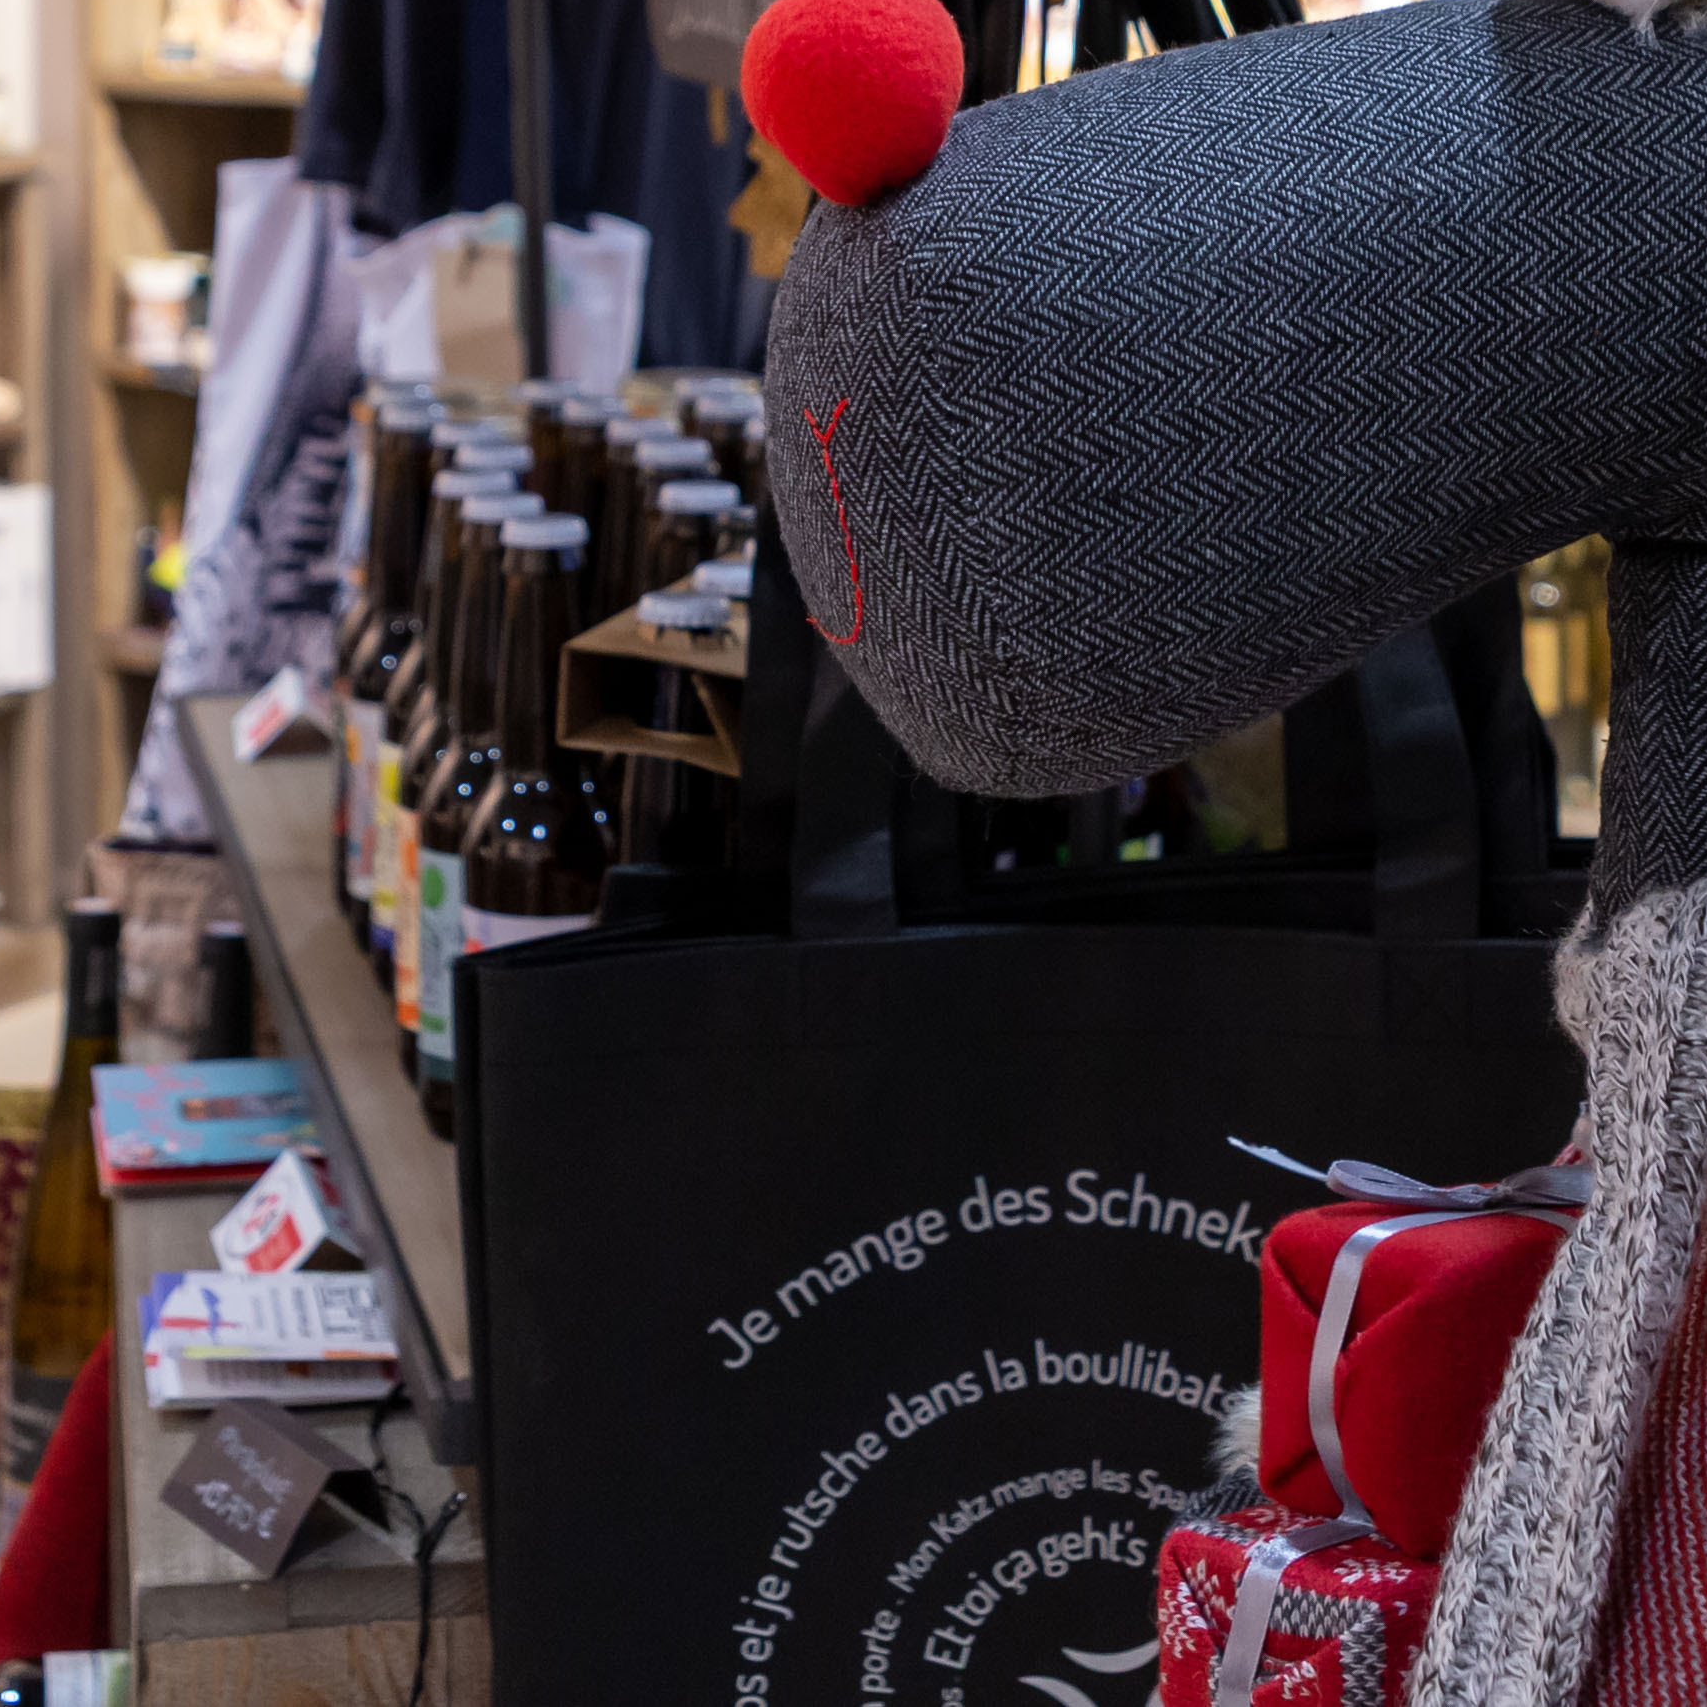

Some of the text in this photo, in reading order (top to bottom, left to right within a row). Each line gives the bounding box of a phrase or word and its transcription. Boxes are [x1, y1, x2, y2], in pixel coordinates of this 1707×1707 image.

[707, 1169, 1262, 1369] Je mange des Schnek
[984, 1349, 1027, 1393] la
[885, 1371, 983, 1438] dans
[770, 1432, 888, 1569] rutsche
[740, 1574, 794, 1620] je
[861, 1609, 901, 1694] porte
[887, 1540, 943, 1593] Mon
[929, 1495, 994, 1550] Katz
[991, 1468, 1086, 1506] mange
[1092, 1460, 1131, 1494] les
[992, 1550, 1038, 1595] ça
[944, 1572, 1001, 1627] toi
[732, 1619, 777, 1662] et
[923, 1626, 975, 1670] Et
